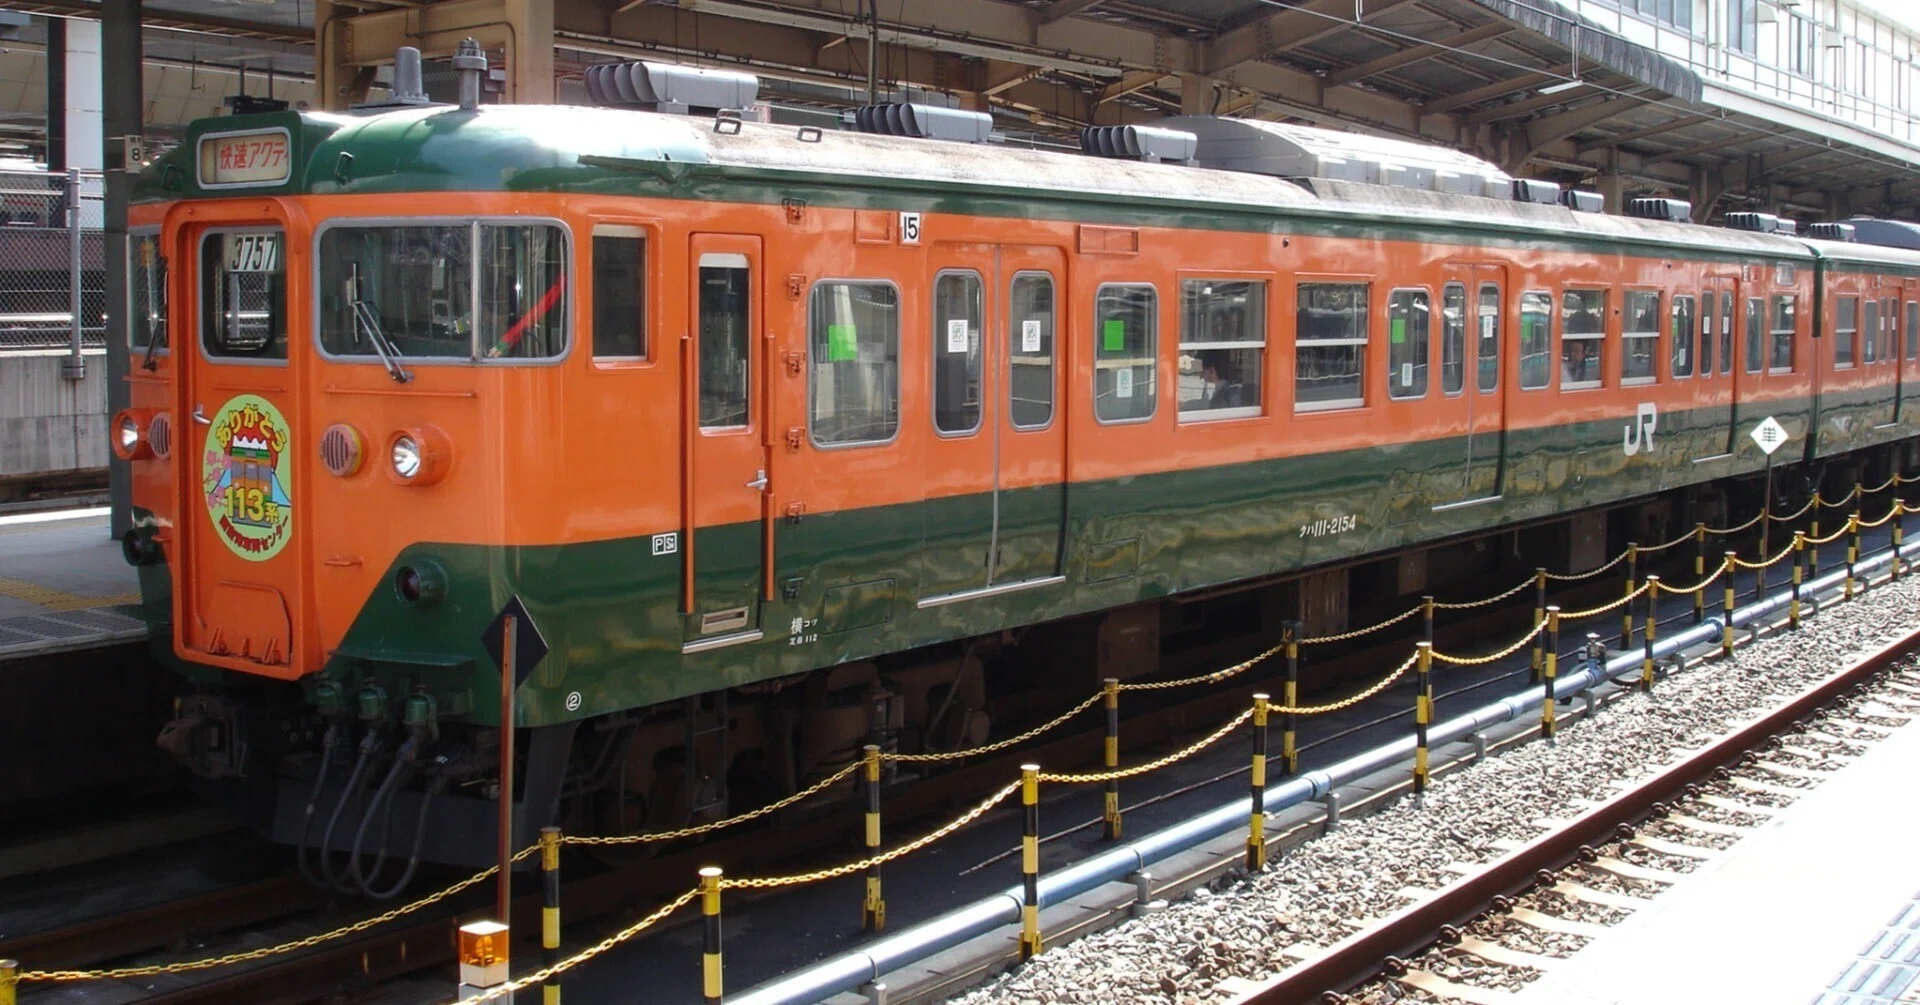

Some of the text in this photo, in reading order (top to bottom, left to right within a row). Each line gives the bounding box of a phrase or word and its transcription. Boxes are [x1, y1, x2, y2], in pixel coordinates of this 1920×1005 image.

[131, 148, 141, 161] 8
[904, 216, 918, 239] 15
[232, 234, 277, 270] 3757
[215, 403, 287, 453] ありがとう
[1623, 402, 1657, 456] JR
